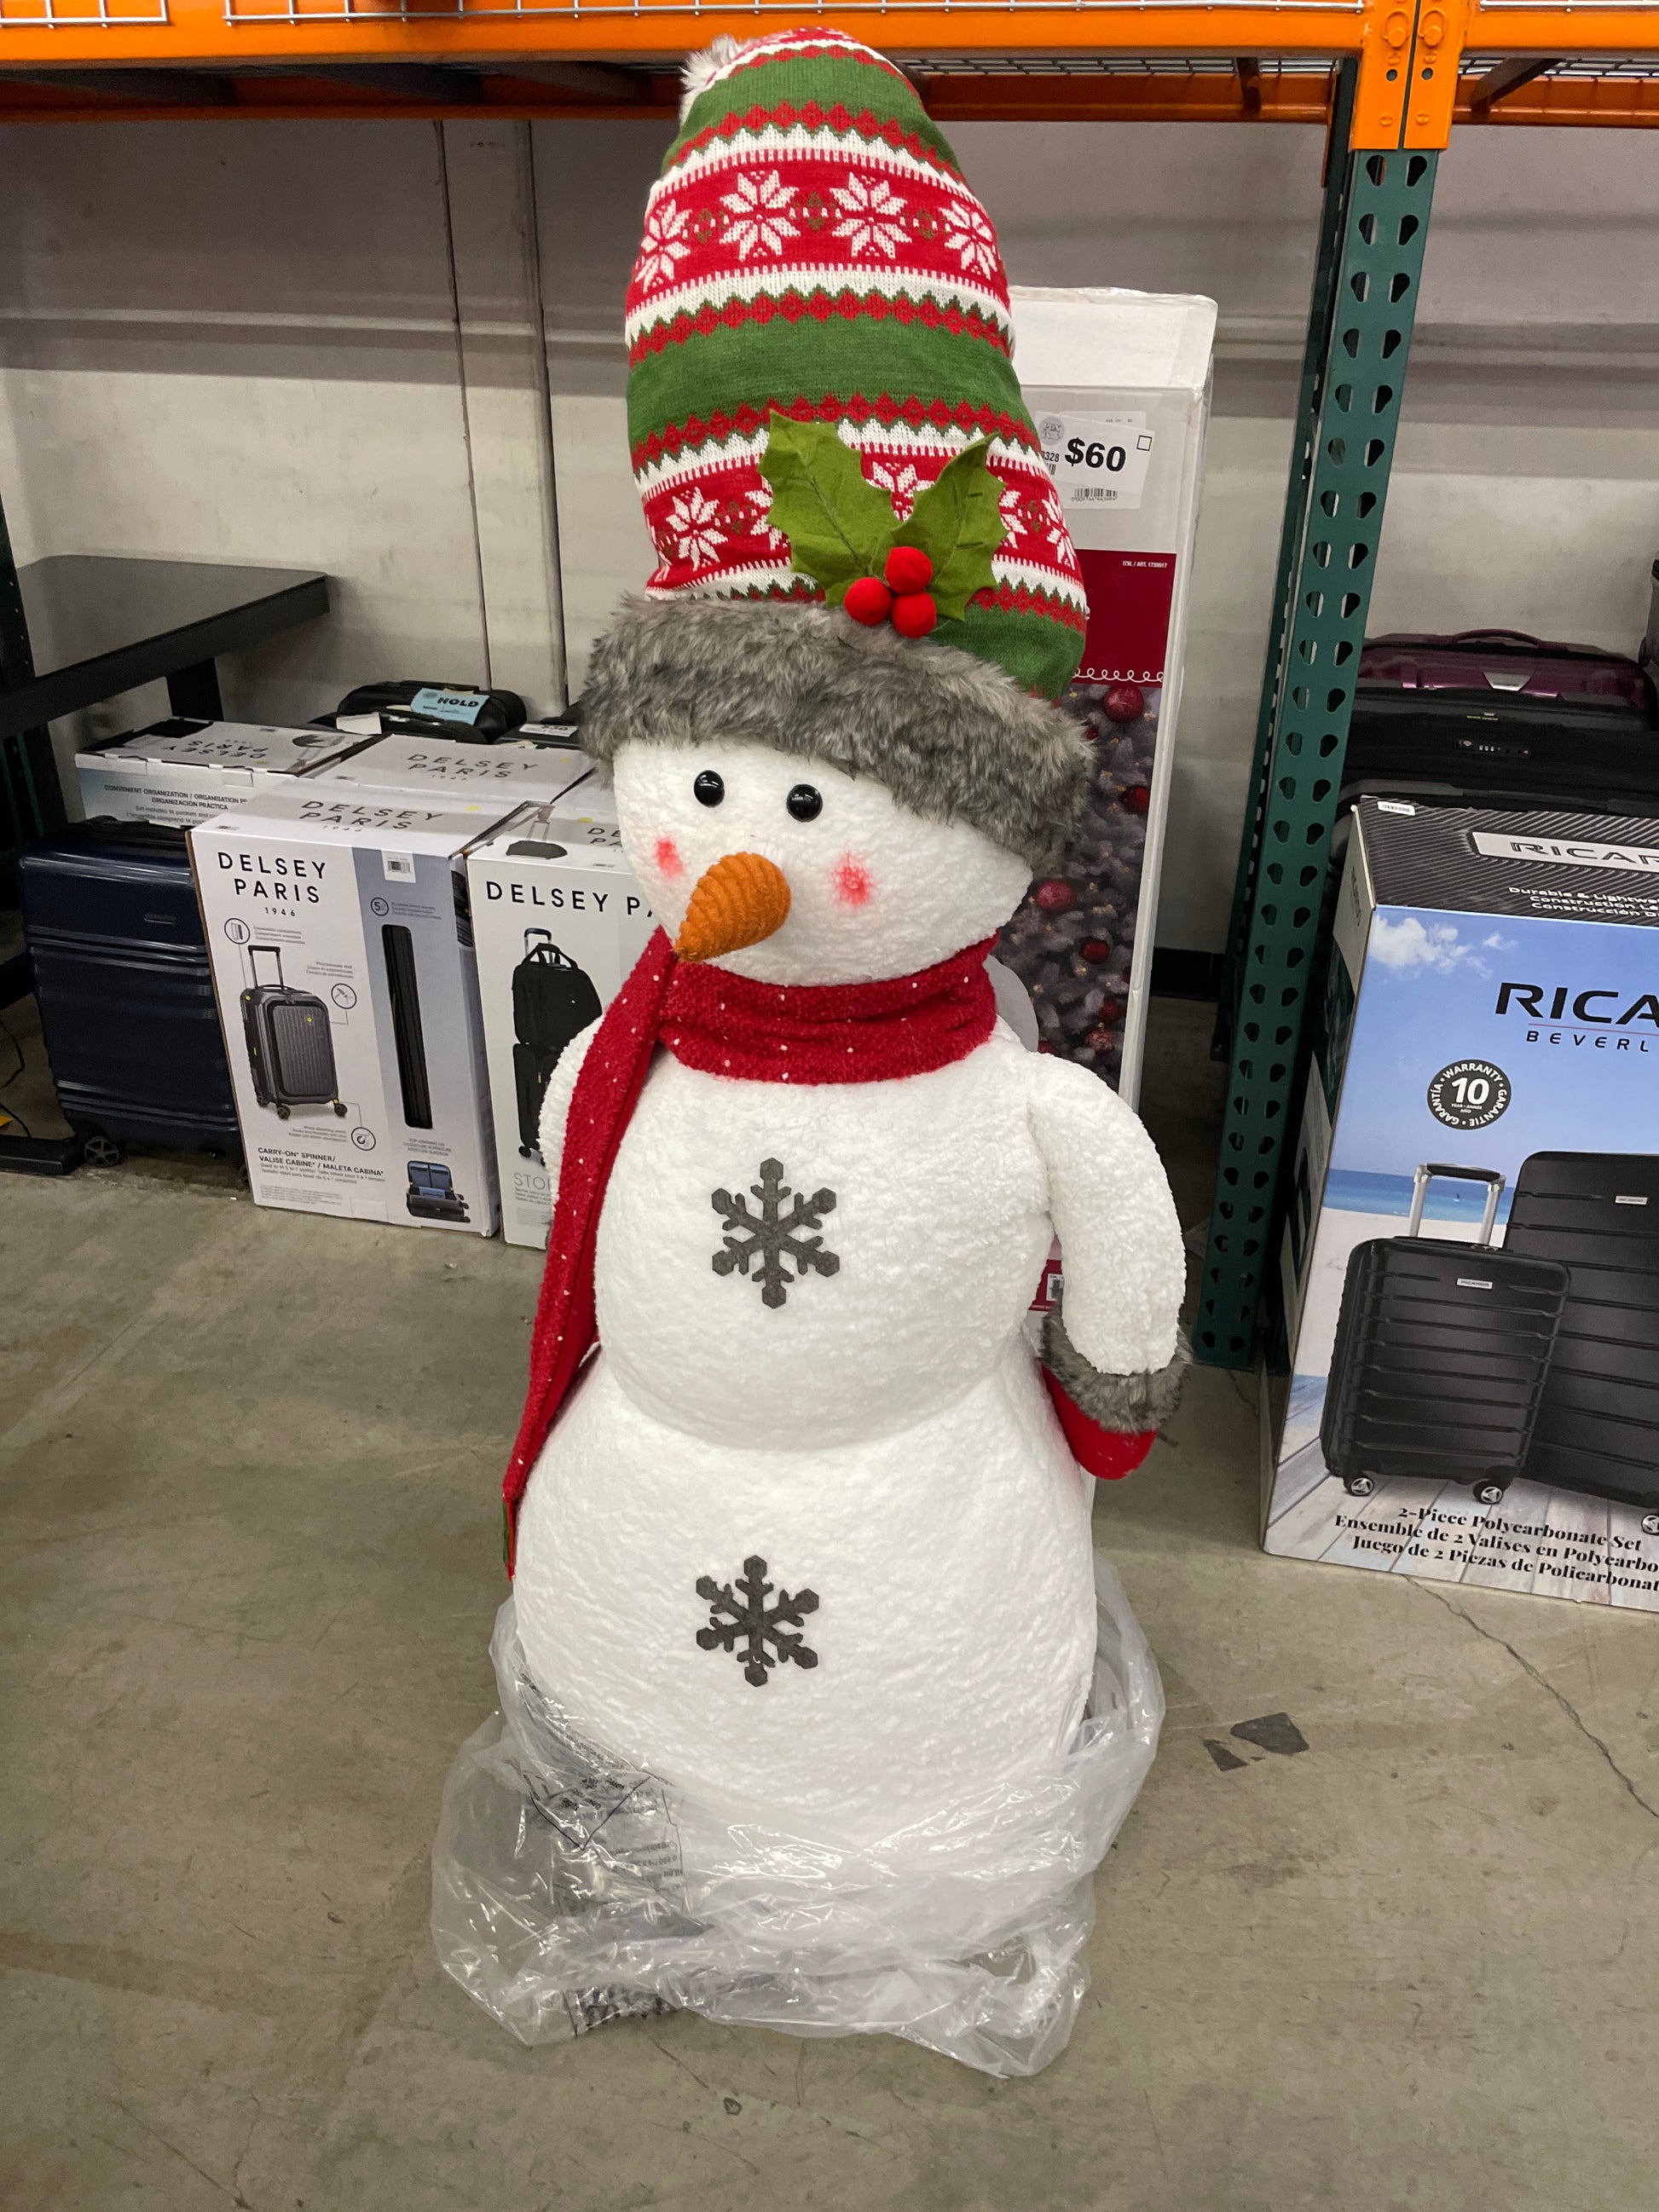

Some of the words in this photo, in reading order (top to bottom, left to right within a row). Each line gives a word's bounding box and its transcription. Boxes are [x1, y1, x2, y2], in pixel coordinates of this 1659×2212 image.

[1064, 436, 1126, 471] $60
[436, 696, 479, 707] HOLD
[407, 754, 539, 771] DELSEY
[408, 763, 512, 779] PARIS
[103, 784, 142, 794] CONVENIENT
[143, 788, 188, 799] ORGANIZATION
[194, 794, 240, 804] ORGANISATION
[298, 812, 413, 829] PARIS
[301, 800, 444, 821] DELSEY
[217, 852, 327, 879] DELSEY
[234, 878, 320, 904] PARIS
[486, 881, 609, 912] DELSEY
[1508, 887, 1573, 898] Durable
[264, 906, 296, 917] 1946
[1529, 896, 1636, 910] Construction
[1531, 903, 1641, 916] Construcción
[1495, 982, 1659, 1029] RICA
[1526, 1030, 1650, 1053] BEVERL
[1442, 1062, 1503, 1082] WARRANTY
[1451, 1077, 1490, 1105] 10
[1430, 1083, 1460, 1125] GARANTÍA
[1469, 1089, 1507, 1126] GARANTIE
[258, 1155, 284, 1164] VALISE
[322, 1163, 351, 1172] MALETA
[513, 1172, 551, 1192] STO
[1397, 1507, 1467, 1527] 2-Piece
[1472, 1515, 1609, 1546] Polycarbonate
[1610, 1535, 1642, 1551] Set
[1335, 1514, 1423, 1538] Ensemble
[1426, 1528, 1449, 1542] de
[1453, 1534, 1464, 1544] 2
[1468, 1533, 1531, 1554] Valises
[1535, 1546, 1558, 1557] en
[1564, 1547, 1659, 1574] Polycarbo
[1351, 1535, 1405, 1555] Juego
[1408, 1543, 1430, 1557] de
[1433, 1550, 1444, 1560] 2
[1448, 1549, 1507, 1568] Piezas
[1511, 1558, 1534, 1573] de
[1538, 1562, 1659, 1592] Policarbonat
